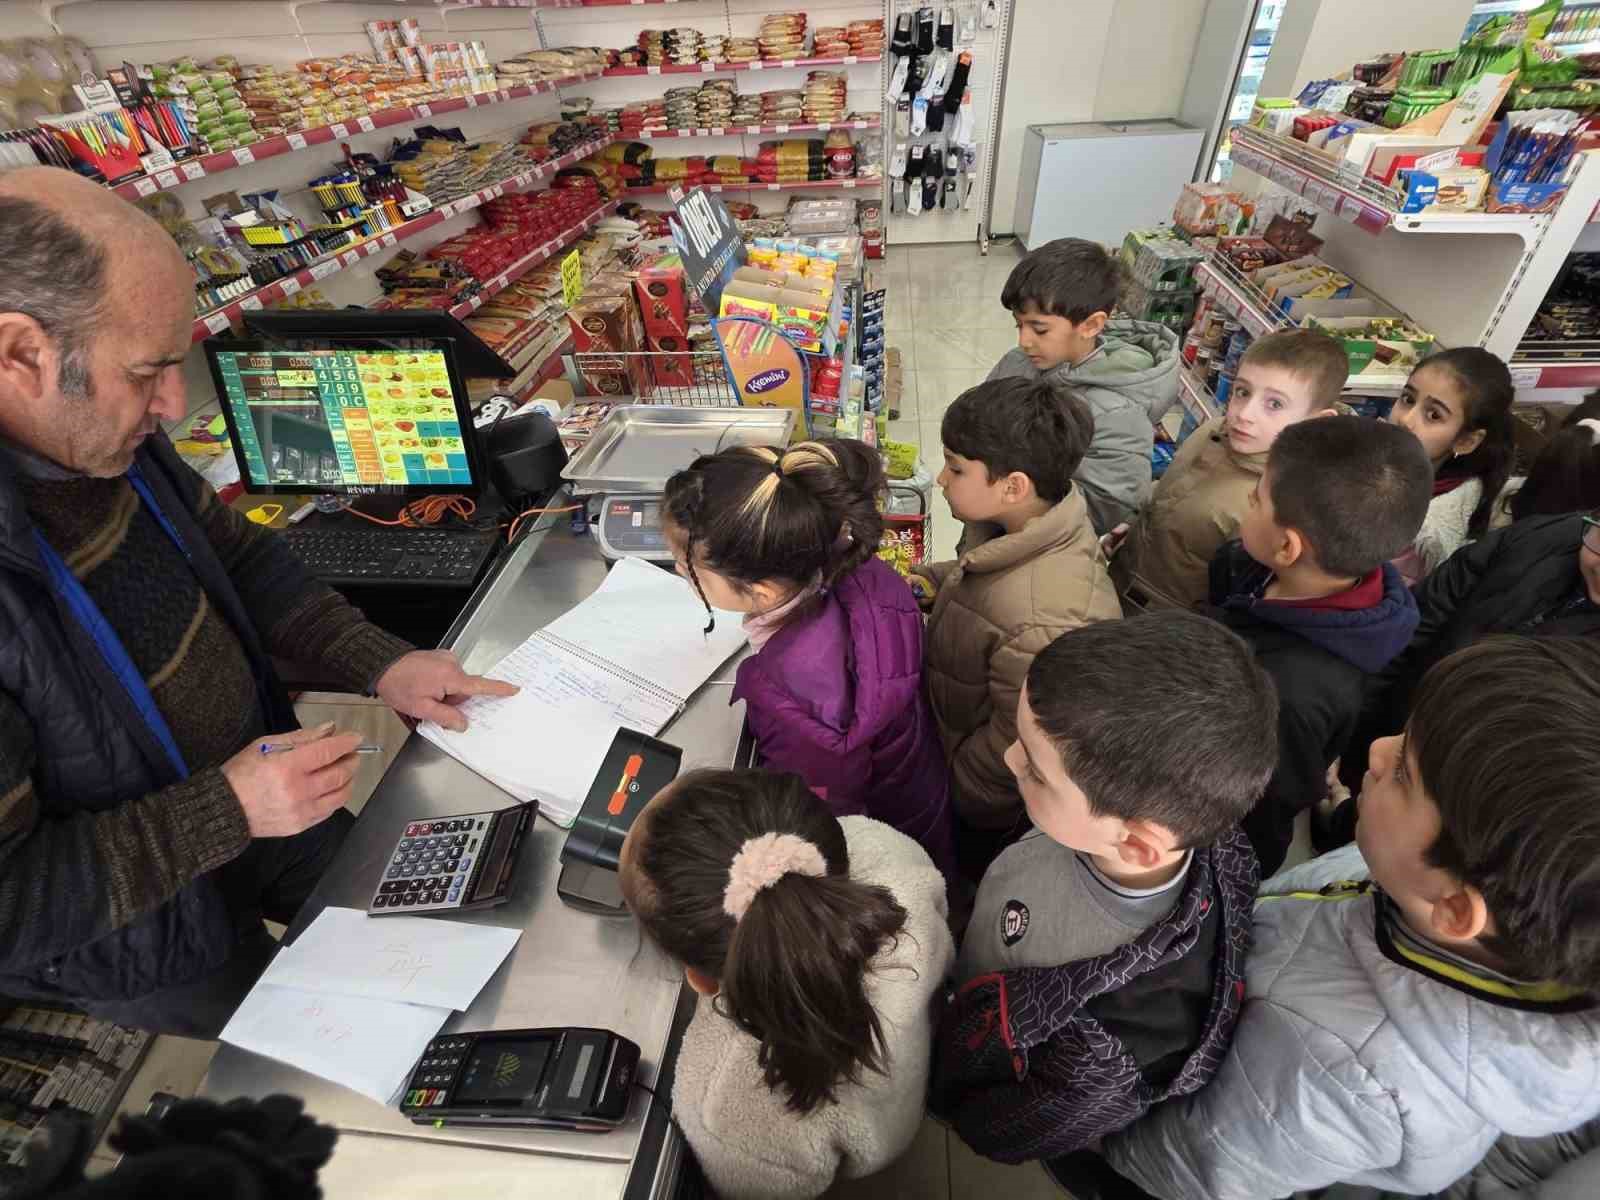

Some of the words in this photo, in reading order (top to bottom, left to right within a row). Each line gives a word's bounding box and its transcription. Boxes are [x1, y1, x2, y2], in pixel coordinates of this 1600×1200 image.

[316, 357, 324, 368] 1
[330, 357, 338, 368] 2
[343, 356, 353, 367] 3
[319, 370, 327, 380] 4
[332, 370, 342, 381] 5
[347, 370, 356, 380] 6
[321, 383, 330, 394] 7
[336, 383, 345, 394] 8
[351, 383, 359, 394] 9
[339, 396, 349, 407] 0
[354, 396, 364, 406] C
